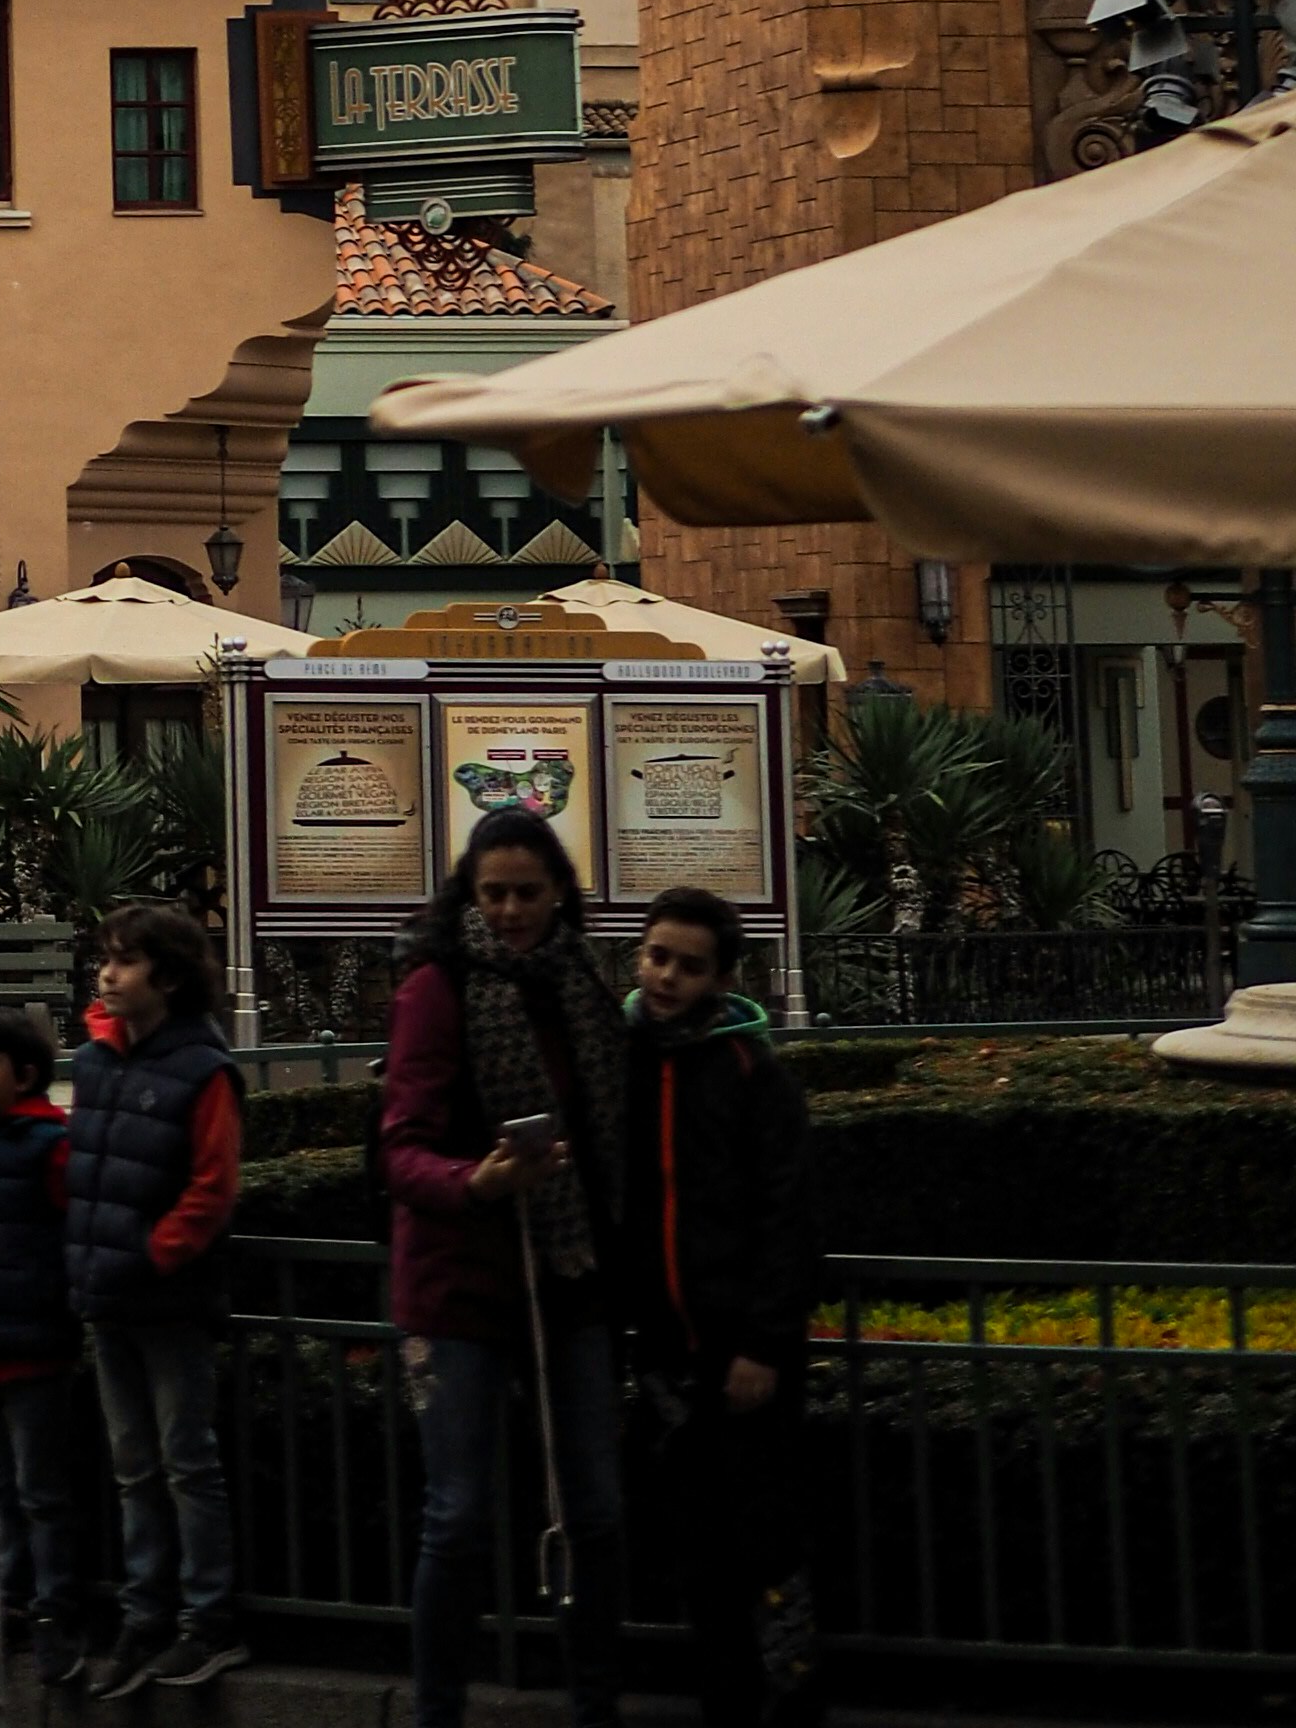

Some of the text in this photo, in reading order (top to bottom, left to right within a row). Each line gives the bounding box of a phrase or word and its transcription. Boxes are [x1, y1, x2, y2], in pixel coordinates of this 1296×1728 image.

[329, 56, 519, 132] LA TERRASSE
[287, 713, 321, 722] VENEZ
[382, 713, 405, 722] NOS
